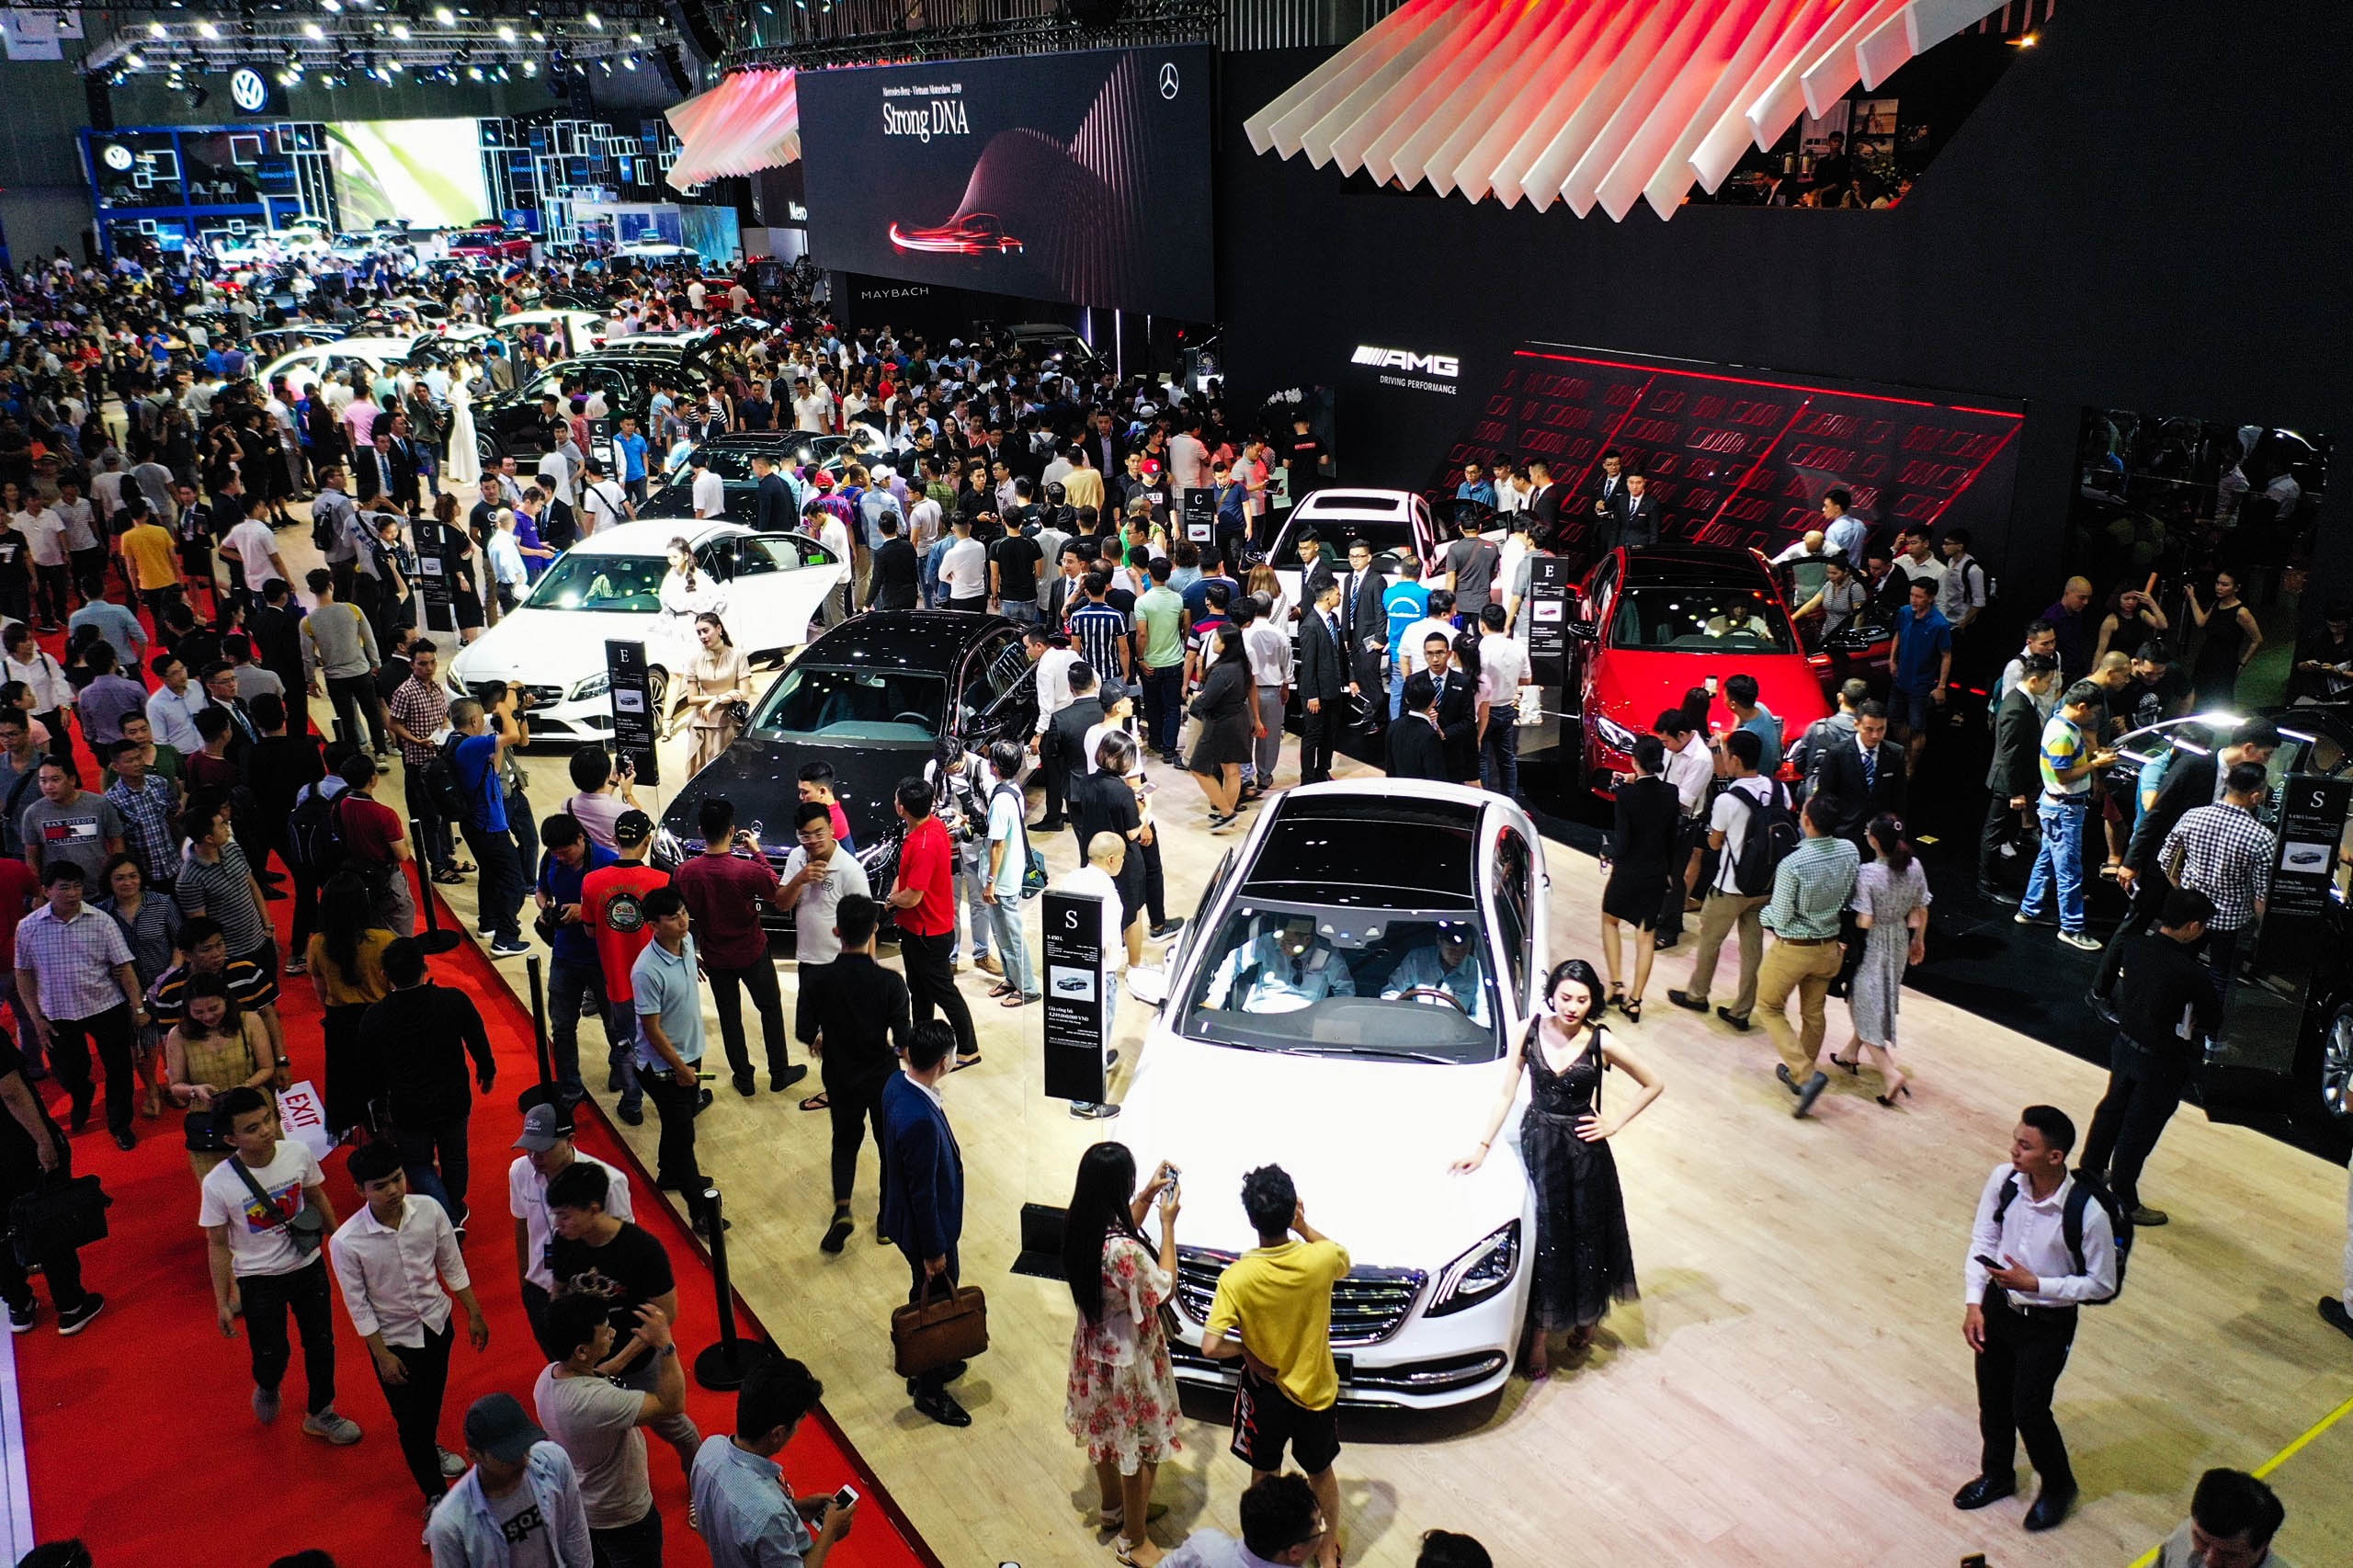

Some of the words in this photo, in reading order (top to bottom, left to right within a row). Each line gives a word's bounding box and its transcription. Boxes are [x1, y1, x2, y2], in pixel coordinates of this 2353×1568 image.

[883, 102, 930, 143] Strong
[931, 100, 970, 134] DNA
[861, 287, 929, 300] MAYBACH
[1381, 349, 1459, 377] AMG
[1380, 375, 1406, 387] DRIVING
[1407, 379, 1457, 395] PERFORMANCE
[596, 424, 603, 433] C
[1195, 494, 1203, 505] C
[423, 527, 430, 537] C
[1544, 565, 1554, 577] E
[620, 649, 630, 663] E
[2310, 790, 2325, 808] S
[1065, 910, 1078, 929] S
[285, 1093, 321, 1127] EXIT
